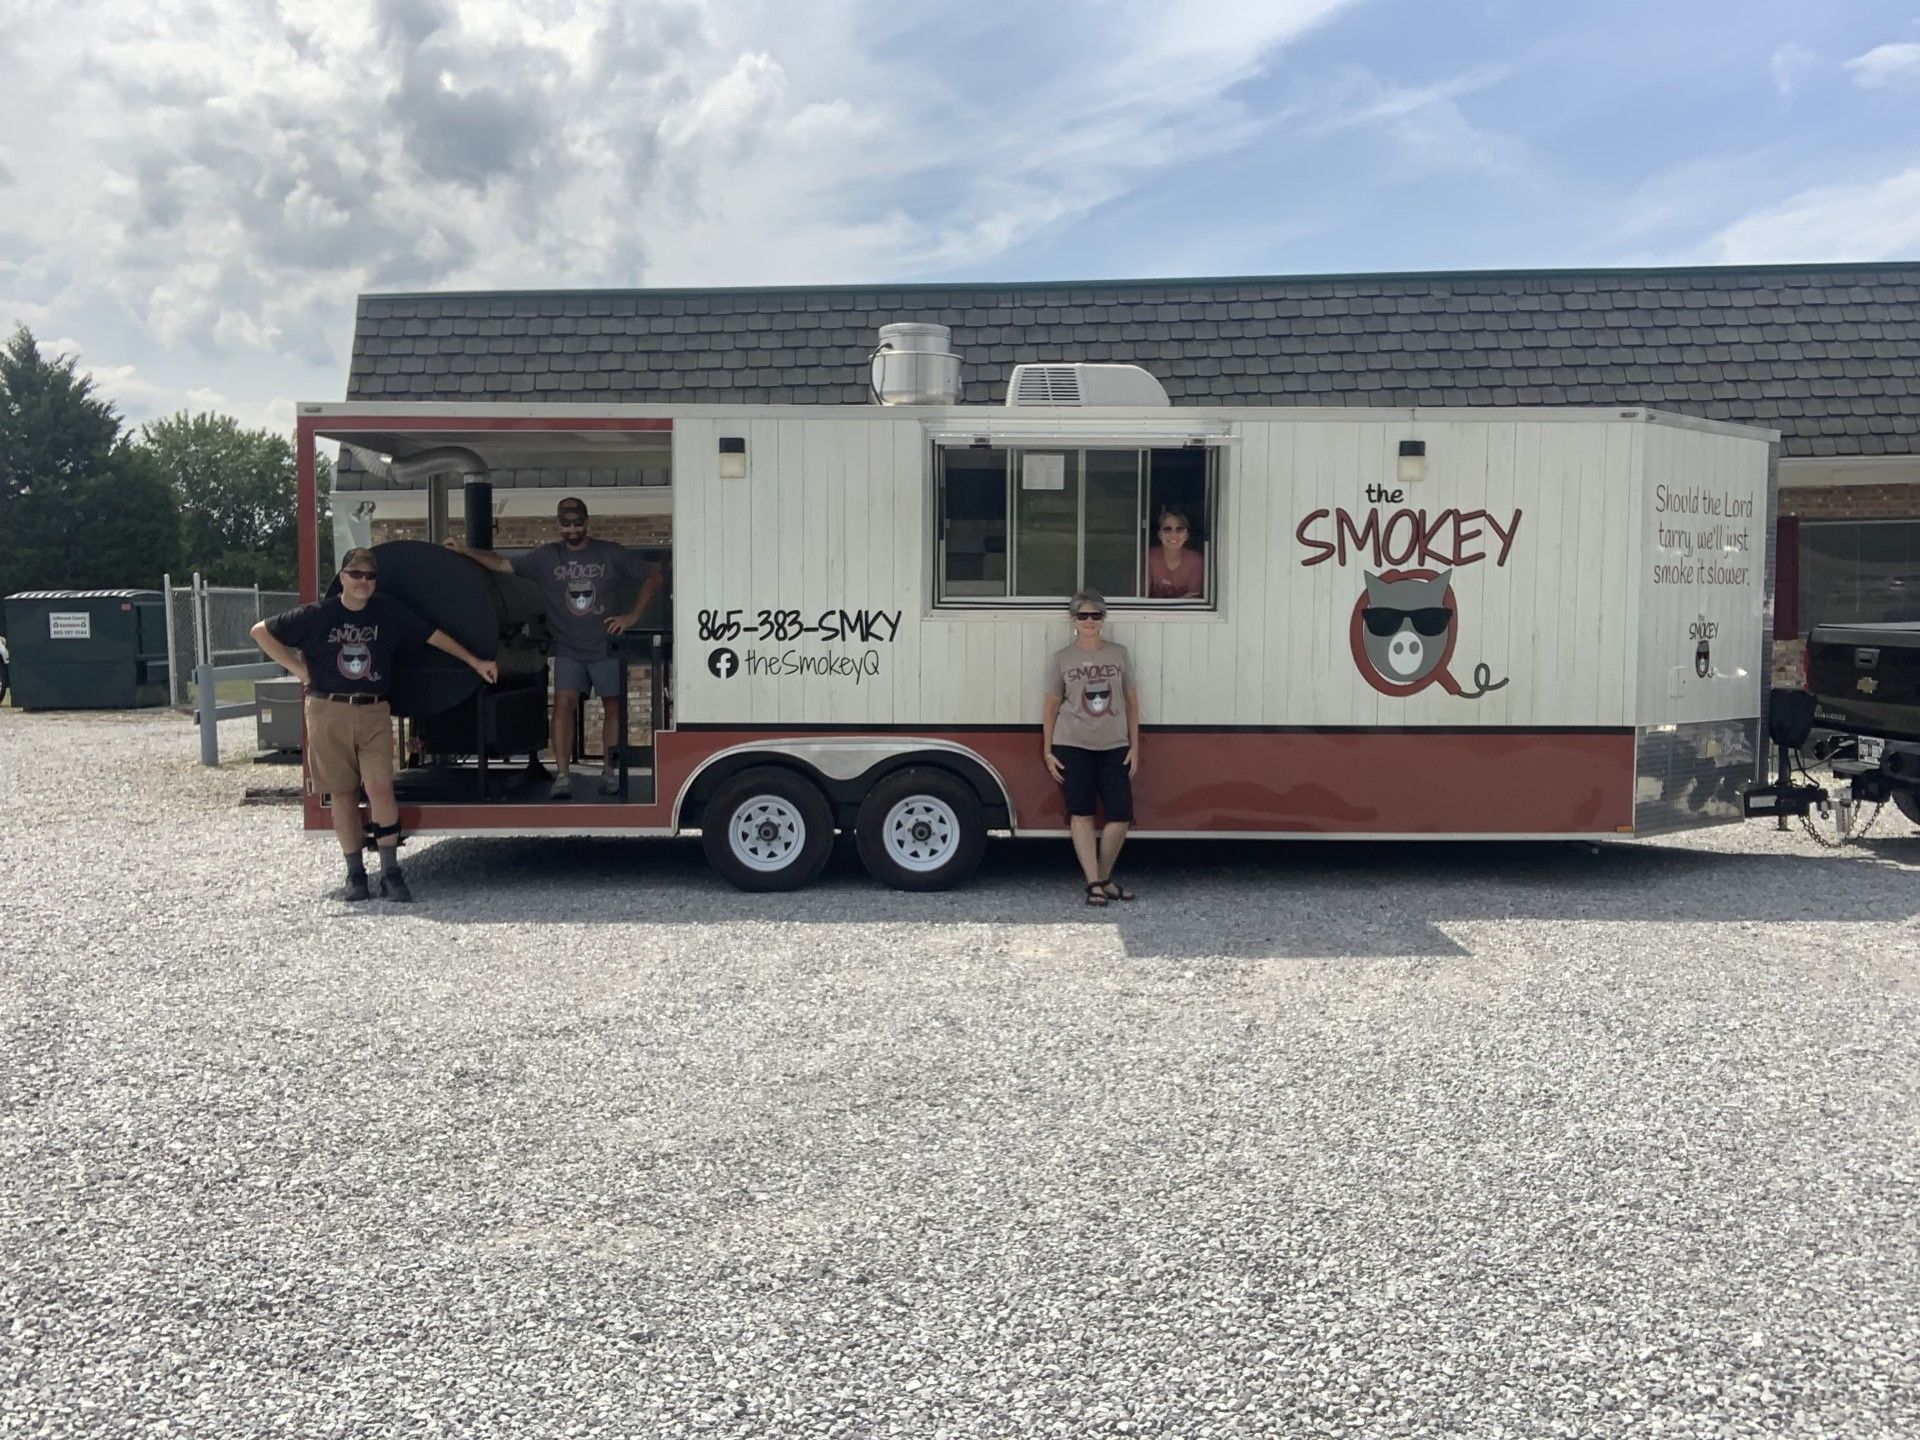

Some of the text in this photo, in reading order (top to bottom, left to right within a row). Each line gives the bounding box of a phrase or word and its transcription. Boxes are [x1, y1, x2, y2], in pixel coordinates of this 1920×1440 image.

[1365, 483, 1404, 503] the
[1655, 484, 1753, 518] Should the Lord
[1296, 507, 1522, 567] SMOKEY
[1659, 520, 1749, 559] tarry, we'll just
[1653, 557, 1750, 587] smoke it slower.
[697, 609, 902, 642] 865-383-SMKY
[744, 649, 880, 685] theSmokeyQ
[1067, 664, 1121, 682] SMOKEY
